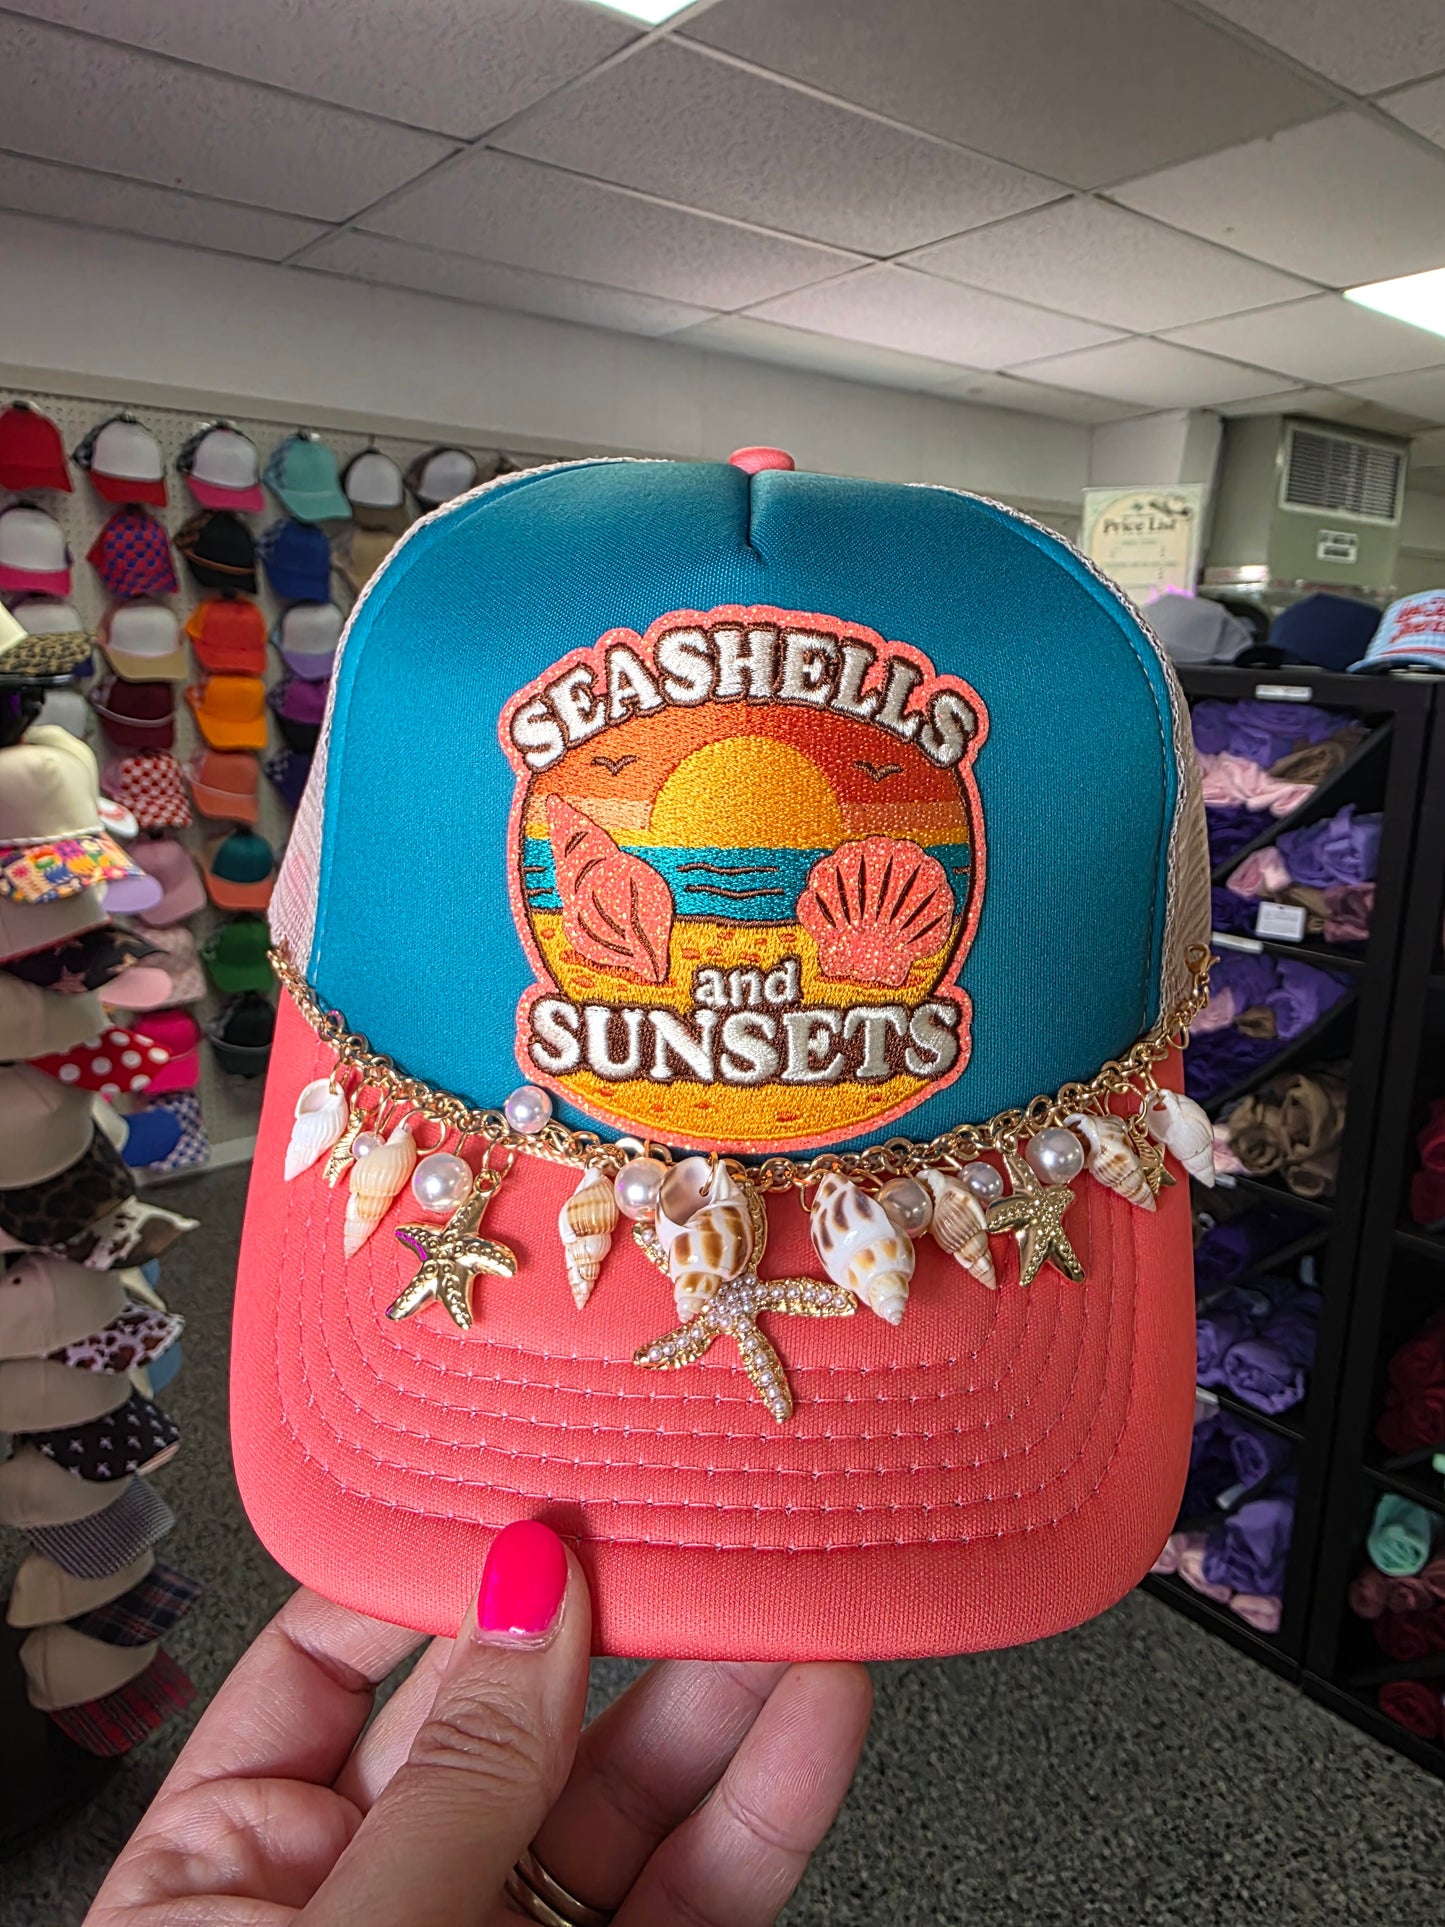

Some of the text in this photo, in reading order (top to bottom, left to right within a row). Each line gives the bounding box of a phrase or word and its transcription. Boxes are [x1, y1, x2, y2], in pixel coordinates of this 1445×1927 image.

[1102, 518, 1144, 535] Price
[512, 622, 977, 769] SEASHELLS
[696, 960, 798, 1006] and
[531, 999, 960, 1081] SUNSETS
